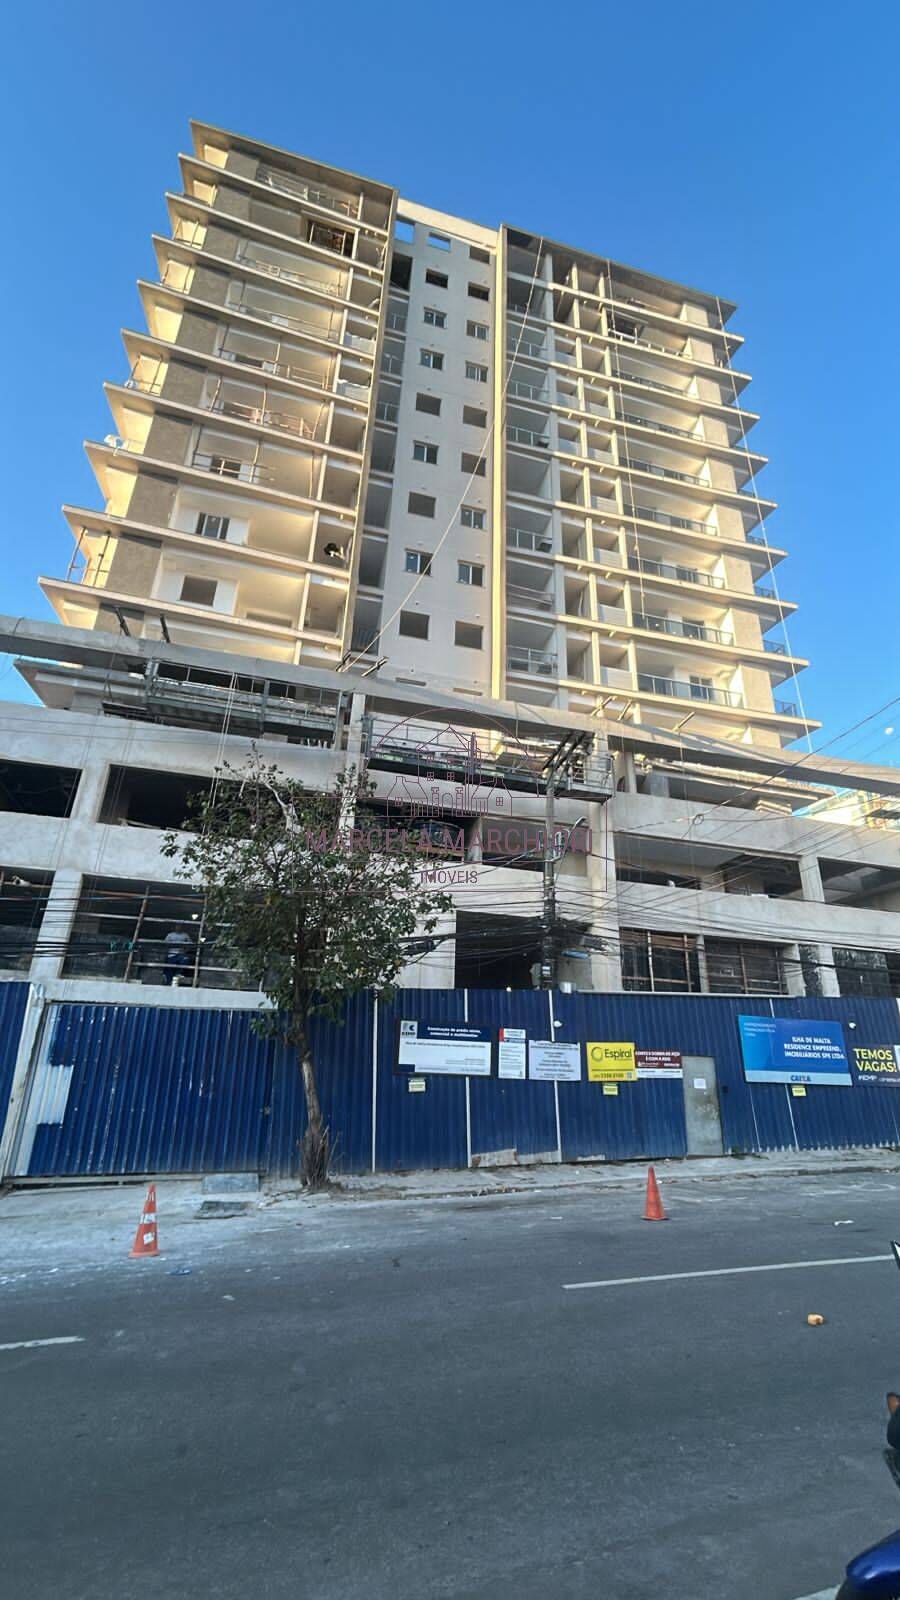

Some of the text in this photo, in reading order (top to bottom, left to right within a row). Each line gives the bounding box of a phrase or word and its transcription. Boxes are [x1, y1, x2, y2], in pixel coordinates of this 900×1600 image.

[604, 1048, 633, 1060] Espiral
[853, 1048, 893, 1061] TEMOS
[855, 1060, 898, 1073] VAGAS!
